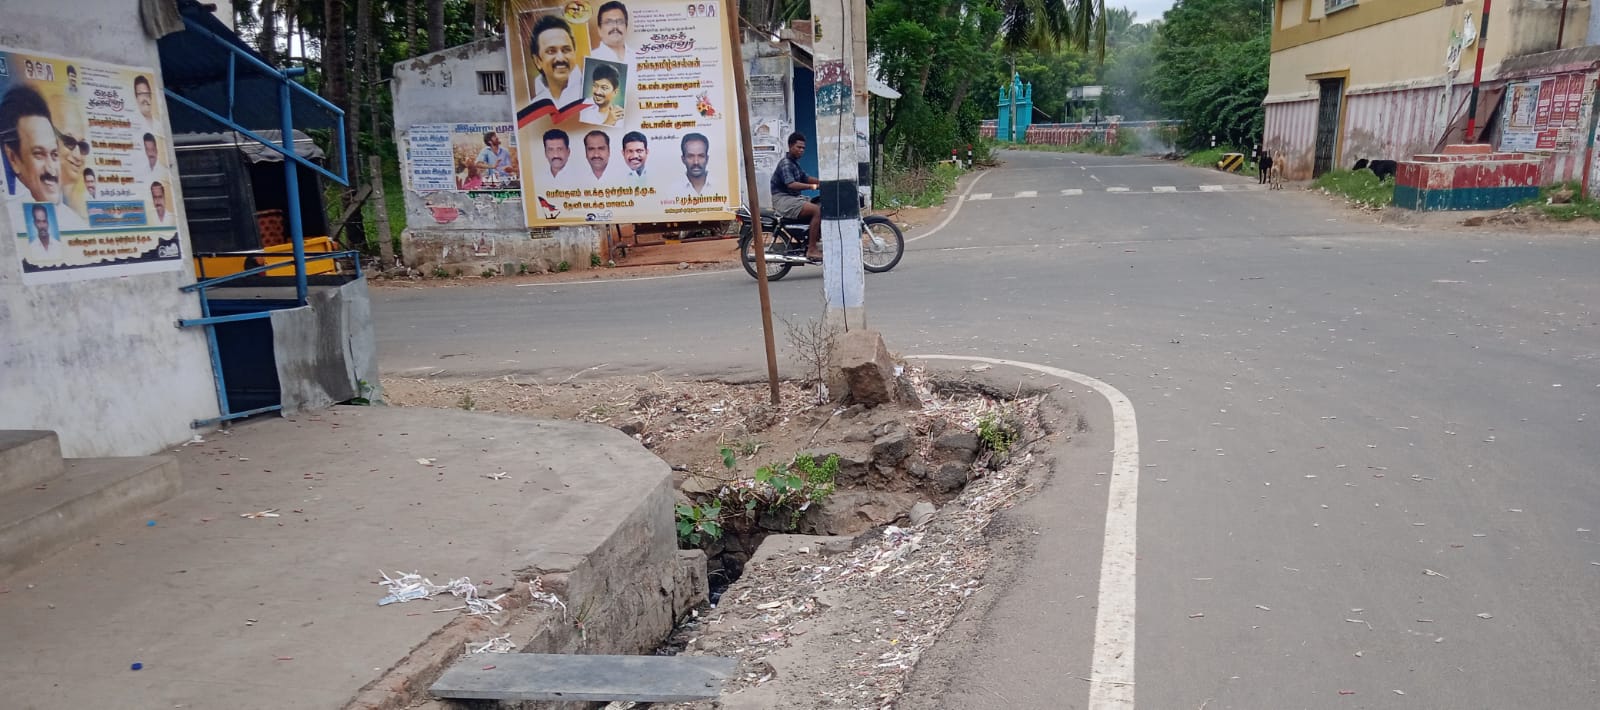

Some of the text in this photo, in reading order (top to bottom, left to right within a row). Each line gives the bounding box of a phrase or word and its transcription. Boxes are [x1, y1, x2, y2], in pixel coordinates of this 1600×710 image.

[635, 38, 697, 54] தலைவர்
[546, 188, 581, 199] பெரியகுளம்
[583, 188, 604, 198] வடக்கு
[563, 199, 635, 211] தேனி வடக்கு மாவட்டம்
